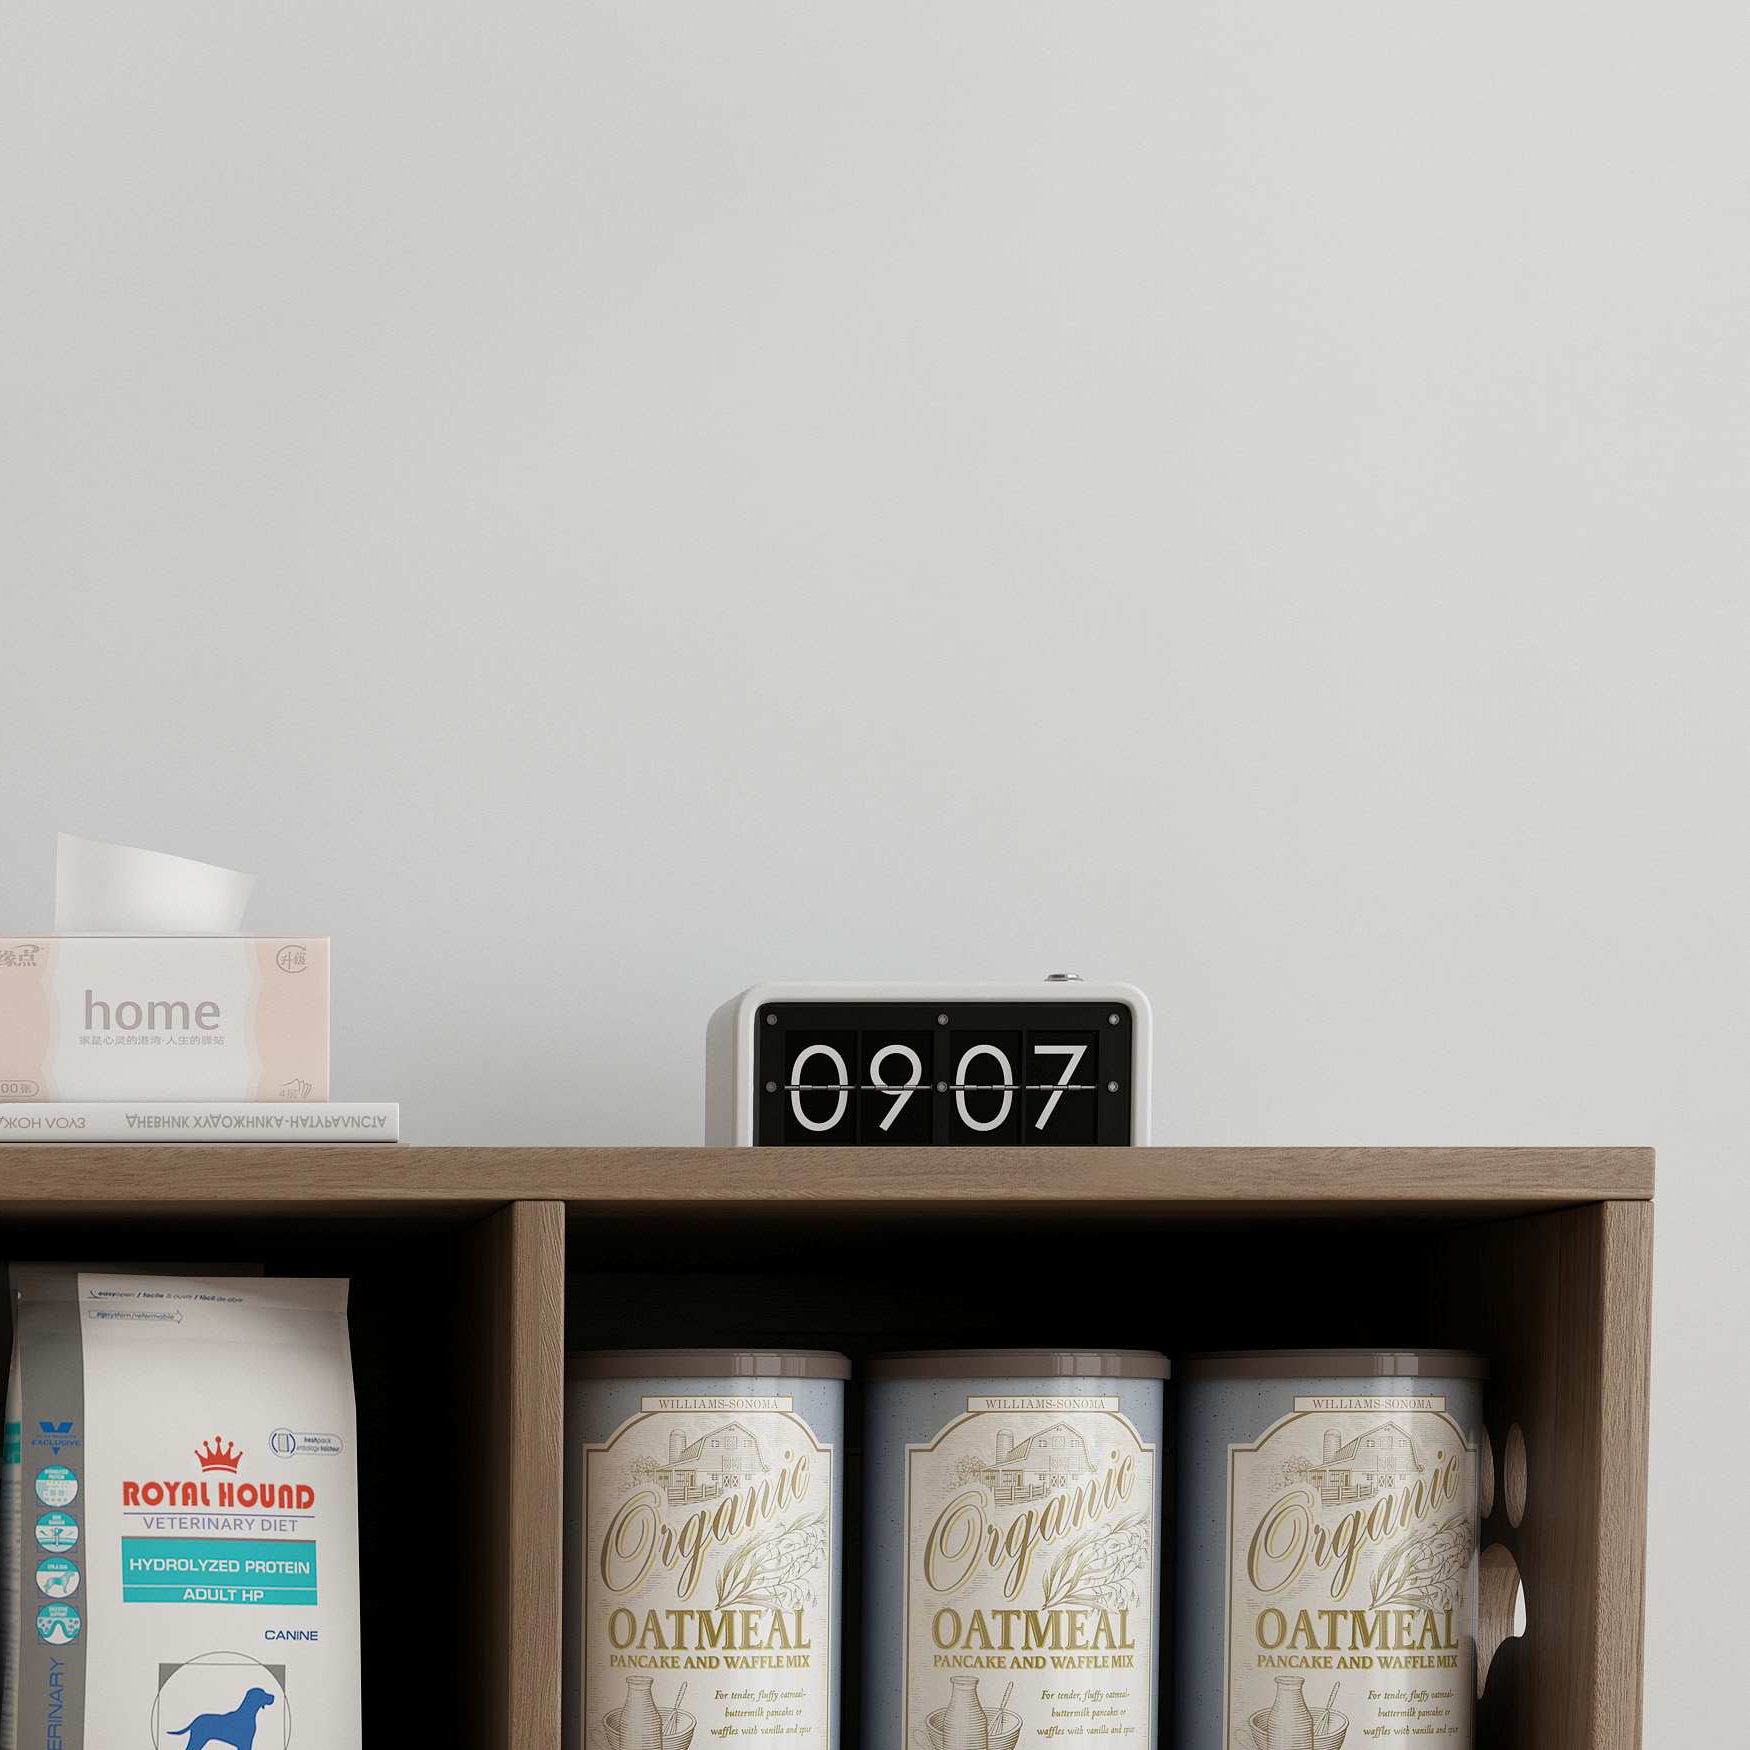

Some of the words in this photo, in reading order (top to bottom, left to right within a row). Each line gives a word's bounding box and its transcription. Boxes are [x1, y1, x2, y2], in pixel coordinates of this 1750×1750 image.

[84, 989, 220, 1031] home
[658, 1399, 778, 1409] WILLIAMS-SONOMA
[600, 1449, 811, 1601] Organic
[608, 1607, 811, 1650] OATMEAL
[609, 1655, 681, 1669] PANCAKE
[684, 1656, 720, 1669] AND
[723, 1655, 784, 1669] WAFFLE
[786, 1655, 810, 1668] MIX
[714, 1690, 728, 1700] For
[731, 1689, 755, 1701] tender,
[756, 1689, 778, 1702] fluffy
[725, 1707, 764, 1717] buttermilk
[711, 1725, 738, 1738] waffles
[741, 1725, 757, 1735] with
